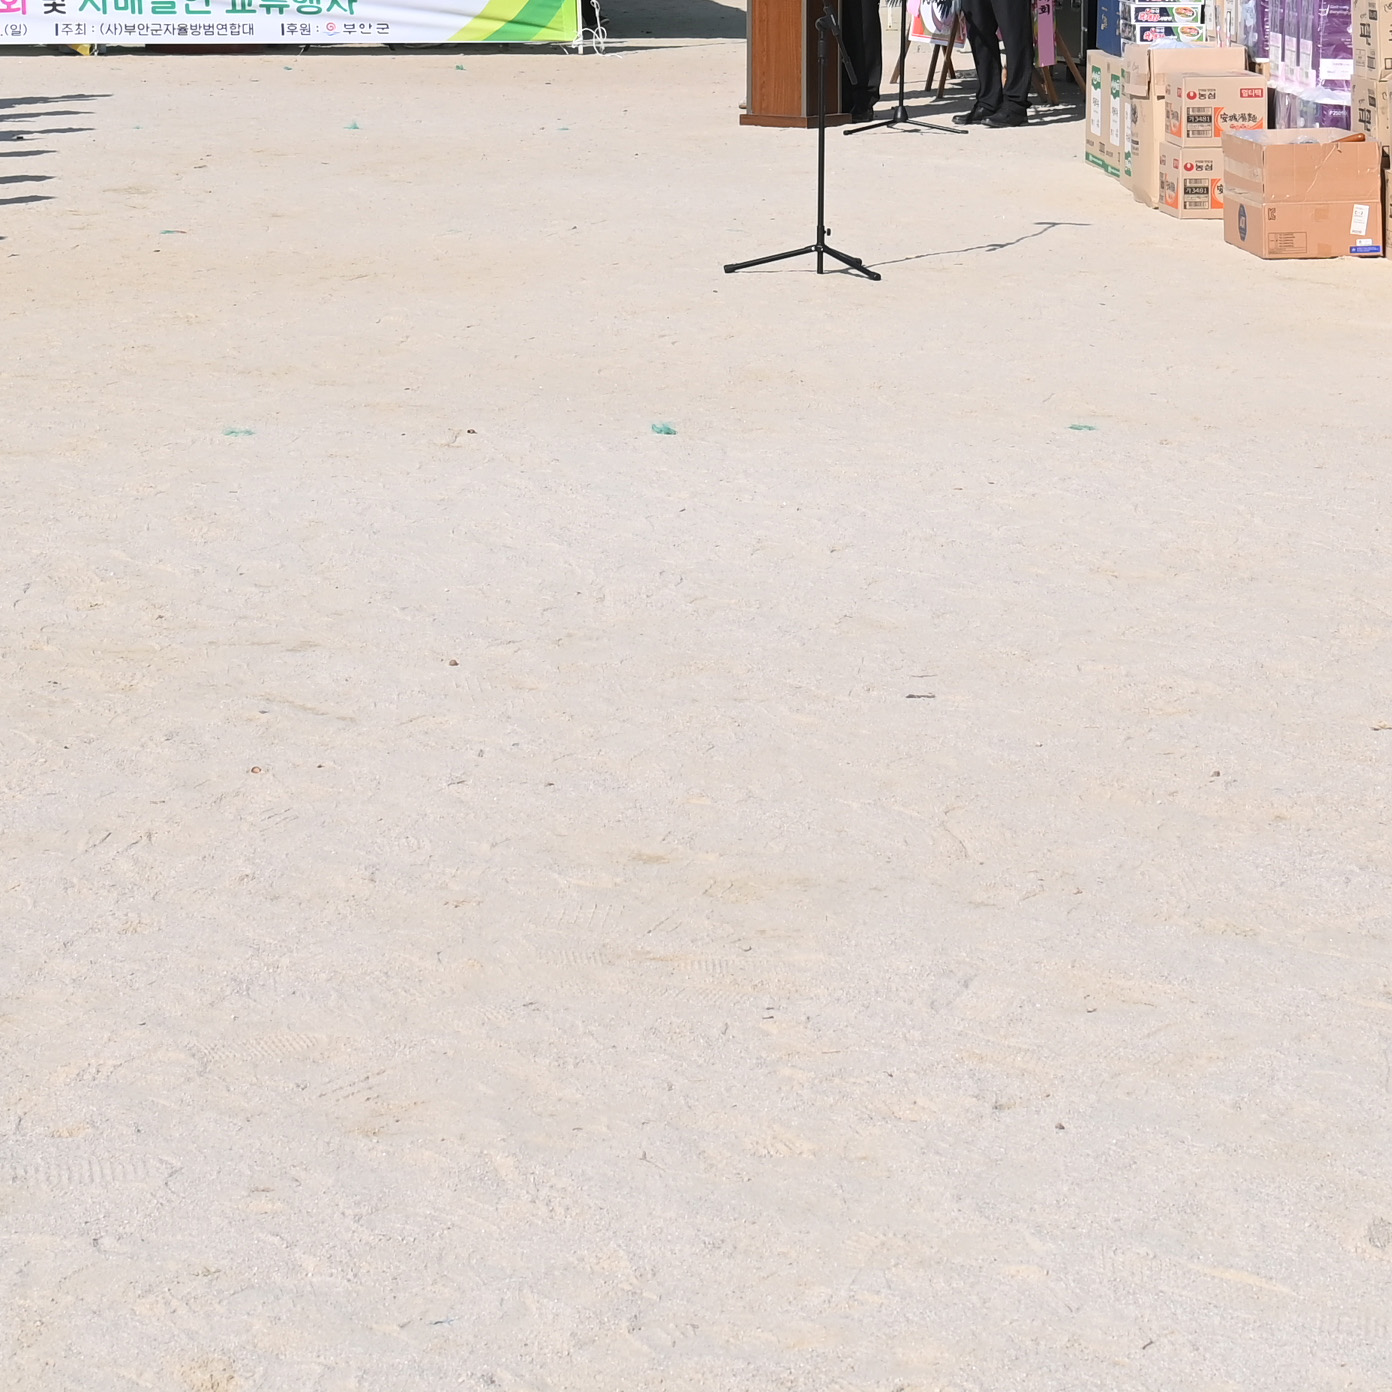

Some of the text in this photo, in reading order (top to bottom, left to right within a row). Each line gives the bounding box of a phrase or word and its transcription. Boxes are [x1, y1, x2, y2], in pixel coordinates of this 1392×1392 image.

[61, 22, 87, 36] 주최
[99, 22, 254, 36] (사)부안군자율방범연합대
[286, 23, 311, 36] 후원
[343, 23, 390, 36] 부안군
[1198, 91, 1216, 99] 농심
[1195, 162, 1213, 171] 농심
